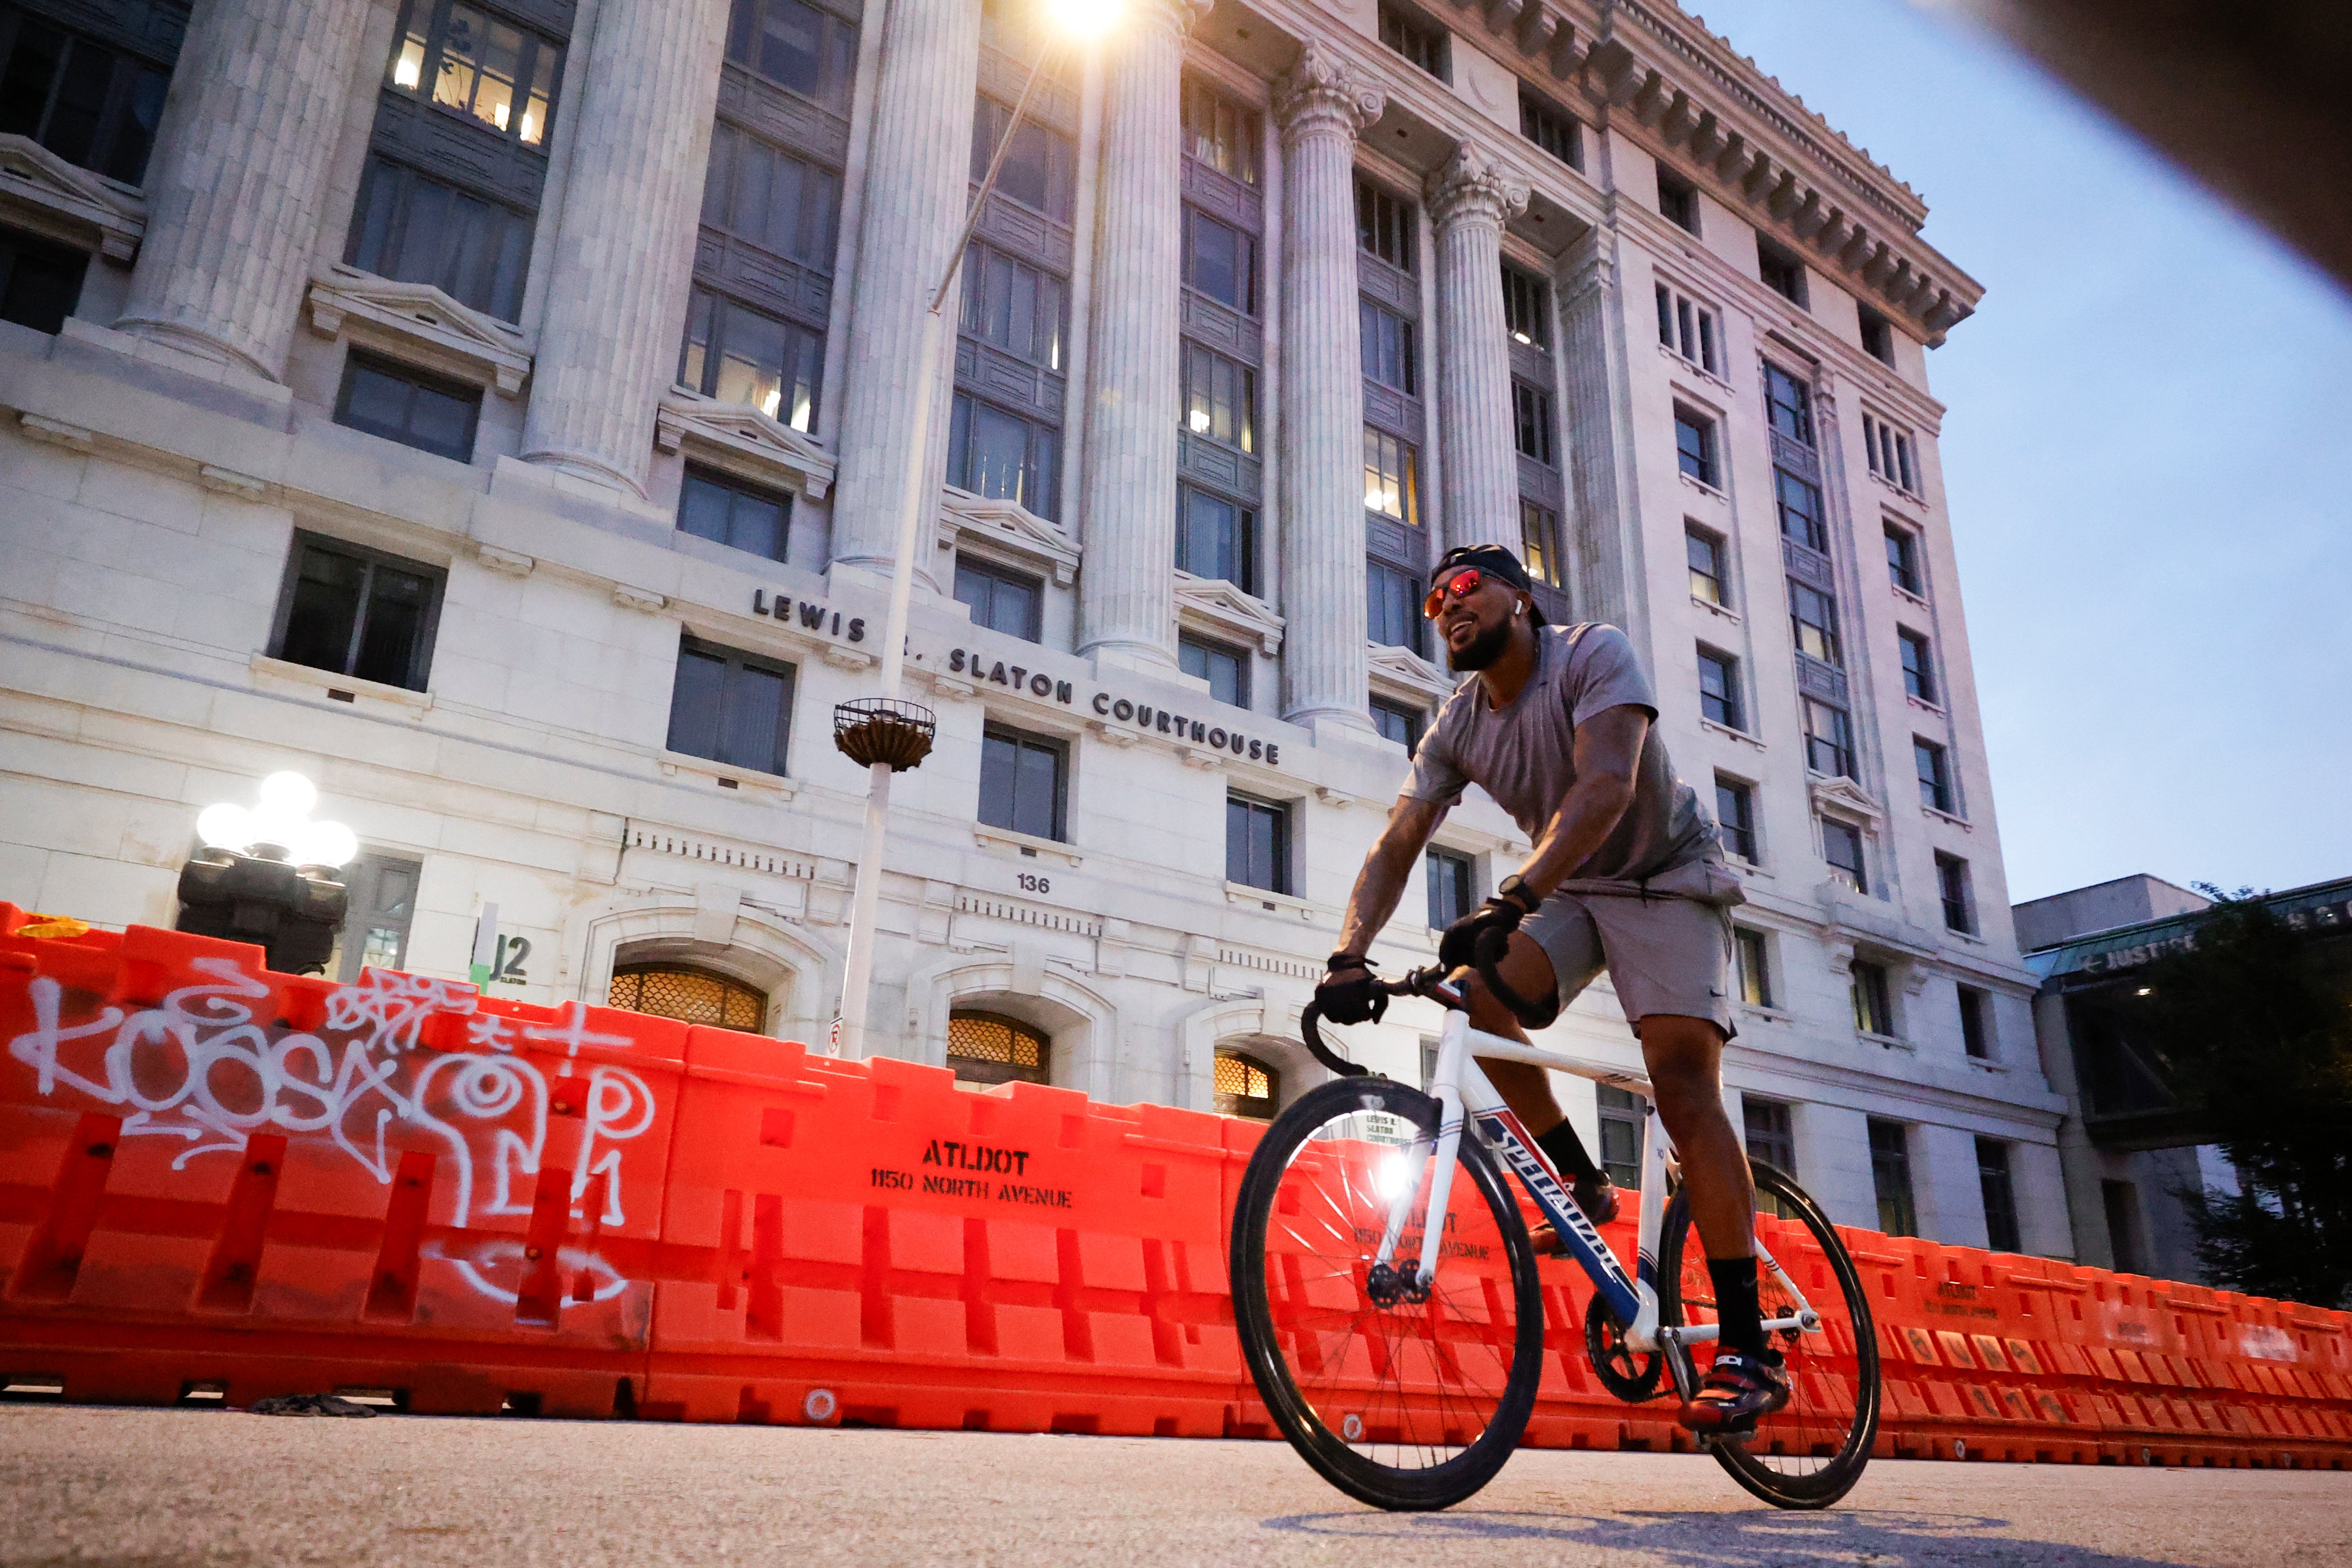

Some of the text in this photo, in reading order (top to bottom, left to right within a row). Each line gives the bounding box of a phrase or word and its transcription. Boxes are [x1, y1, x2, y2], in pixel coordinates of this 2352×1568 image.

[754, 589, 865, 642] LEWIS
[950, 648, 1072, 704] SLATON
[1092, 693, 1279, 764] COURTHOUSE
[1017, 873, 1050, 895] 136
[871, 1169, 1072, 1209] 1150 NORTH AVENUE
[1492, 1129, 1619, 1272] SPECIALIZED
